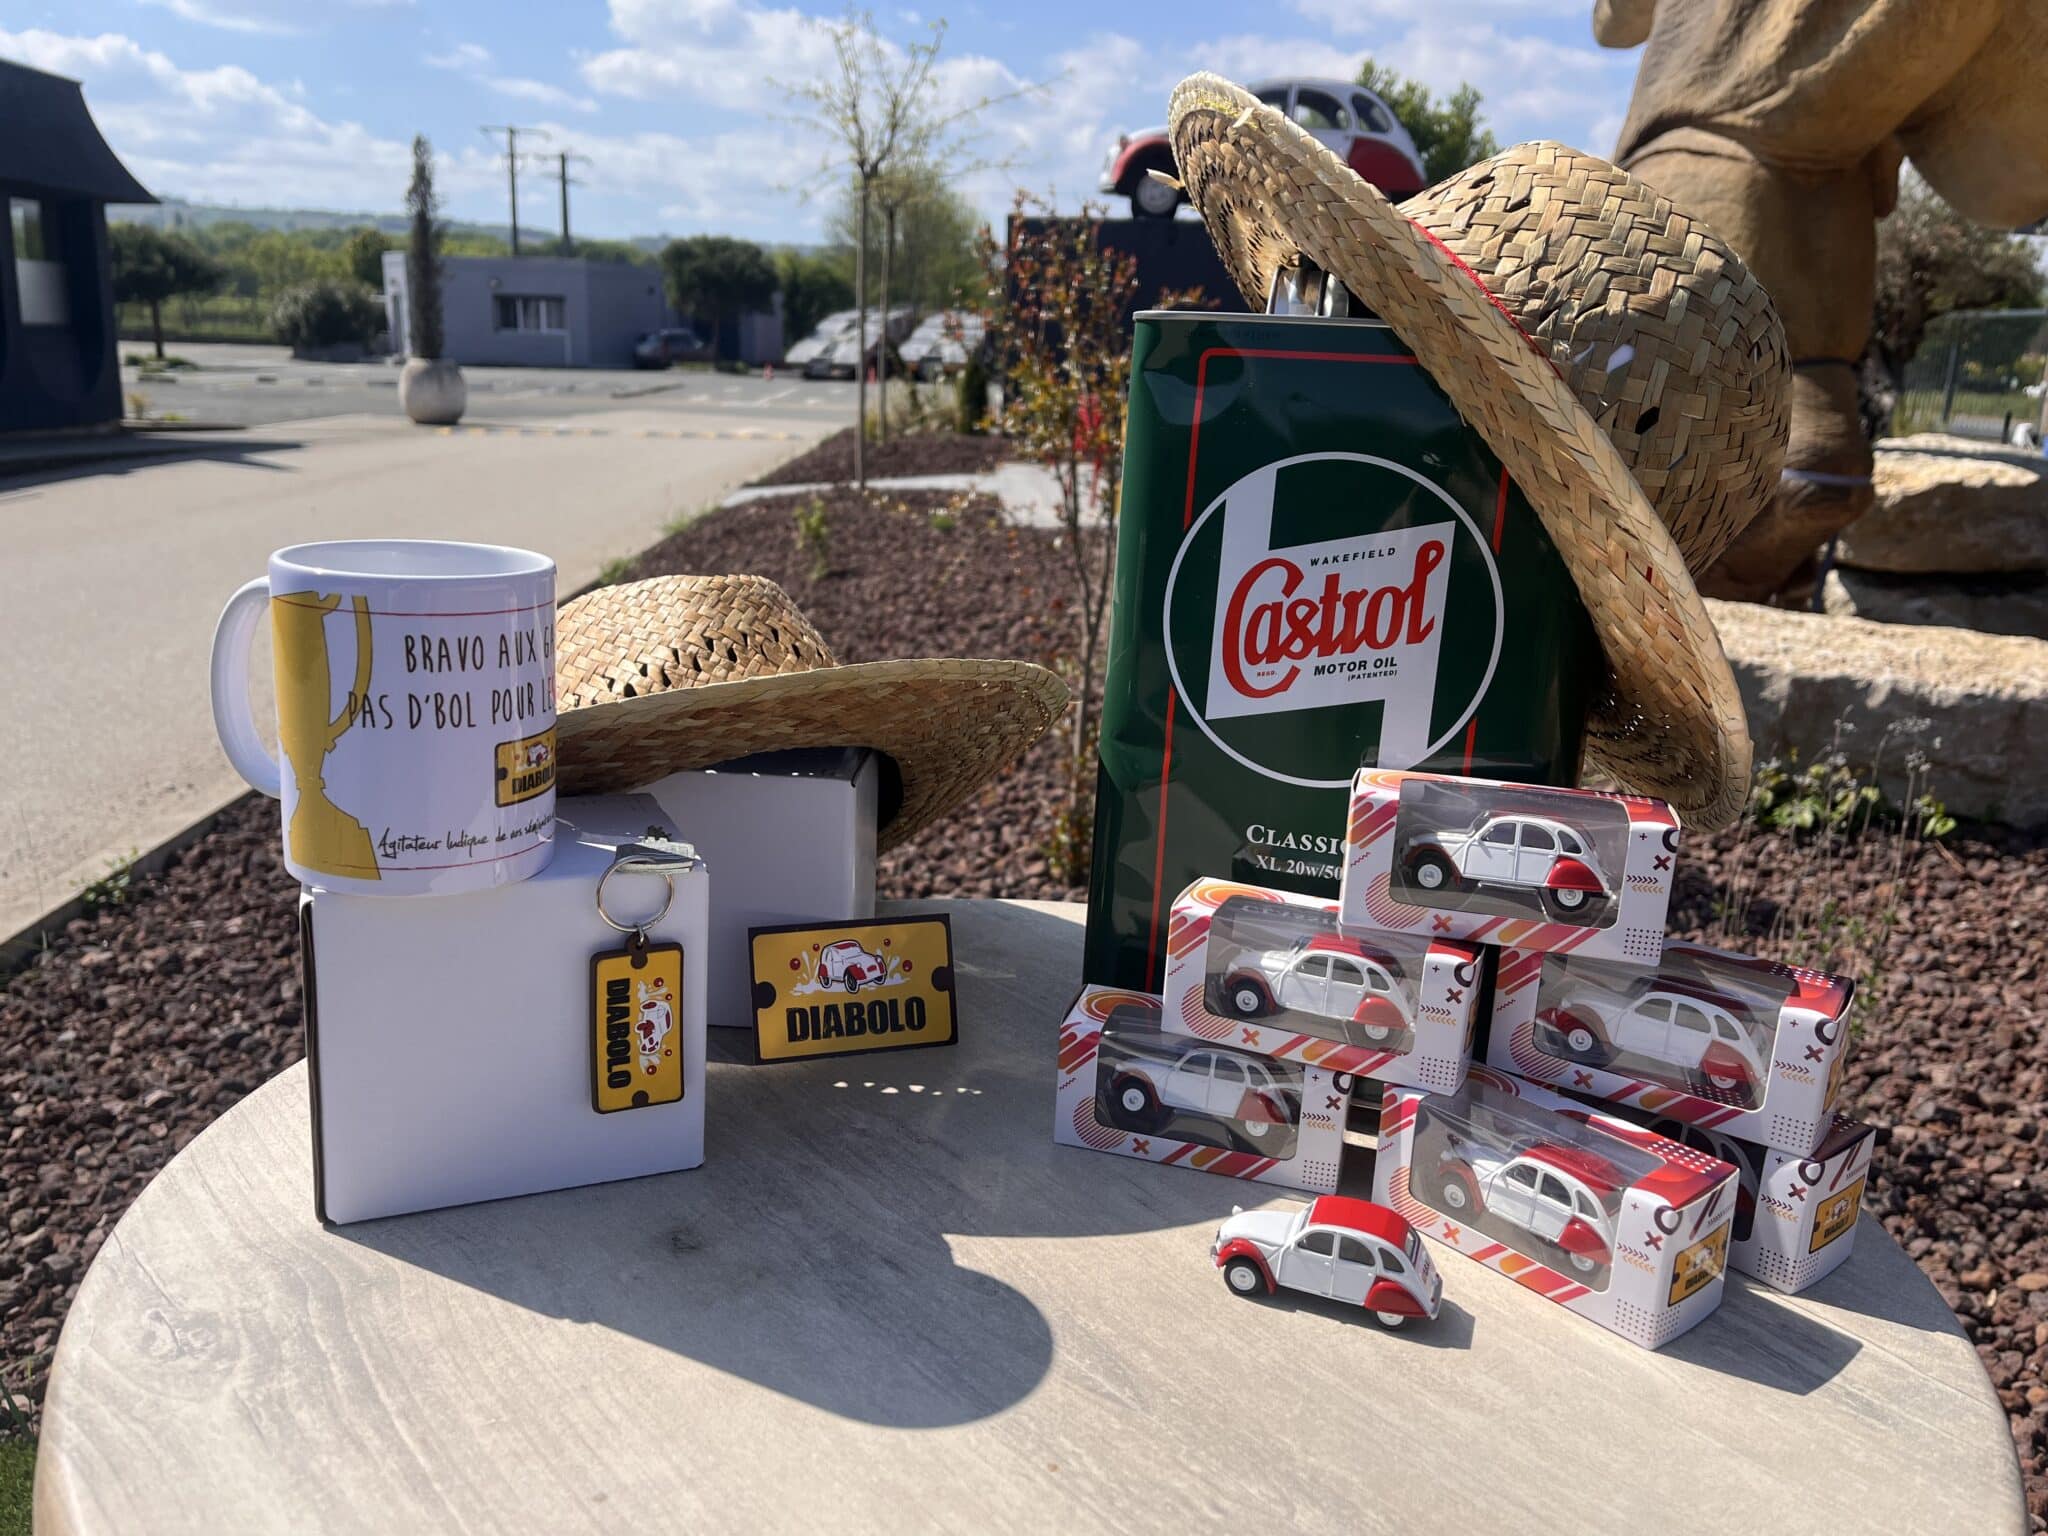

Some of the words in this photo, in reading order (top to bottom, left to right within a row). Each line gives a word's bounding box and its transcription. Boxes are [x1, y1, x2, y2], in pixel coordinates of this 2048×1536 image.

[1310, 547, 1397, 567] WAKEFIELD
[1222, 539, 1446, 699] Castrol
[404, 634, 484, 673] BRAVO
[498, 628, 537, 669] AUX
[1314, 660, 1367, 676] MOTOR
[1373, 656, 1398, 669] OIL
[1347, 669, 1398, 682] (PATENTED)
[347, 690, 393, 730] PAS
[408, 691, 477, 730] D'BOL
[492, 682, 534, 725] POUR
[378, 827, 442, 859] Agitateur
[495, 826, 508, 842] de
[1256, 854, 1281, 872] XL
[606, 977, 632, 1089] DIABOLO
[786, 996, 926, 1043] DIABOLO
